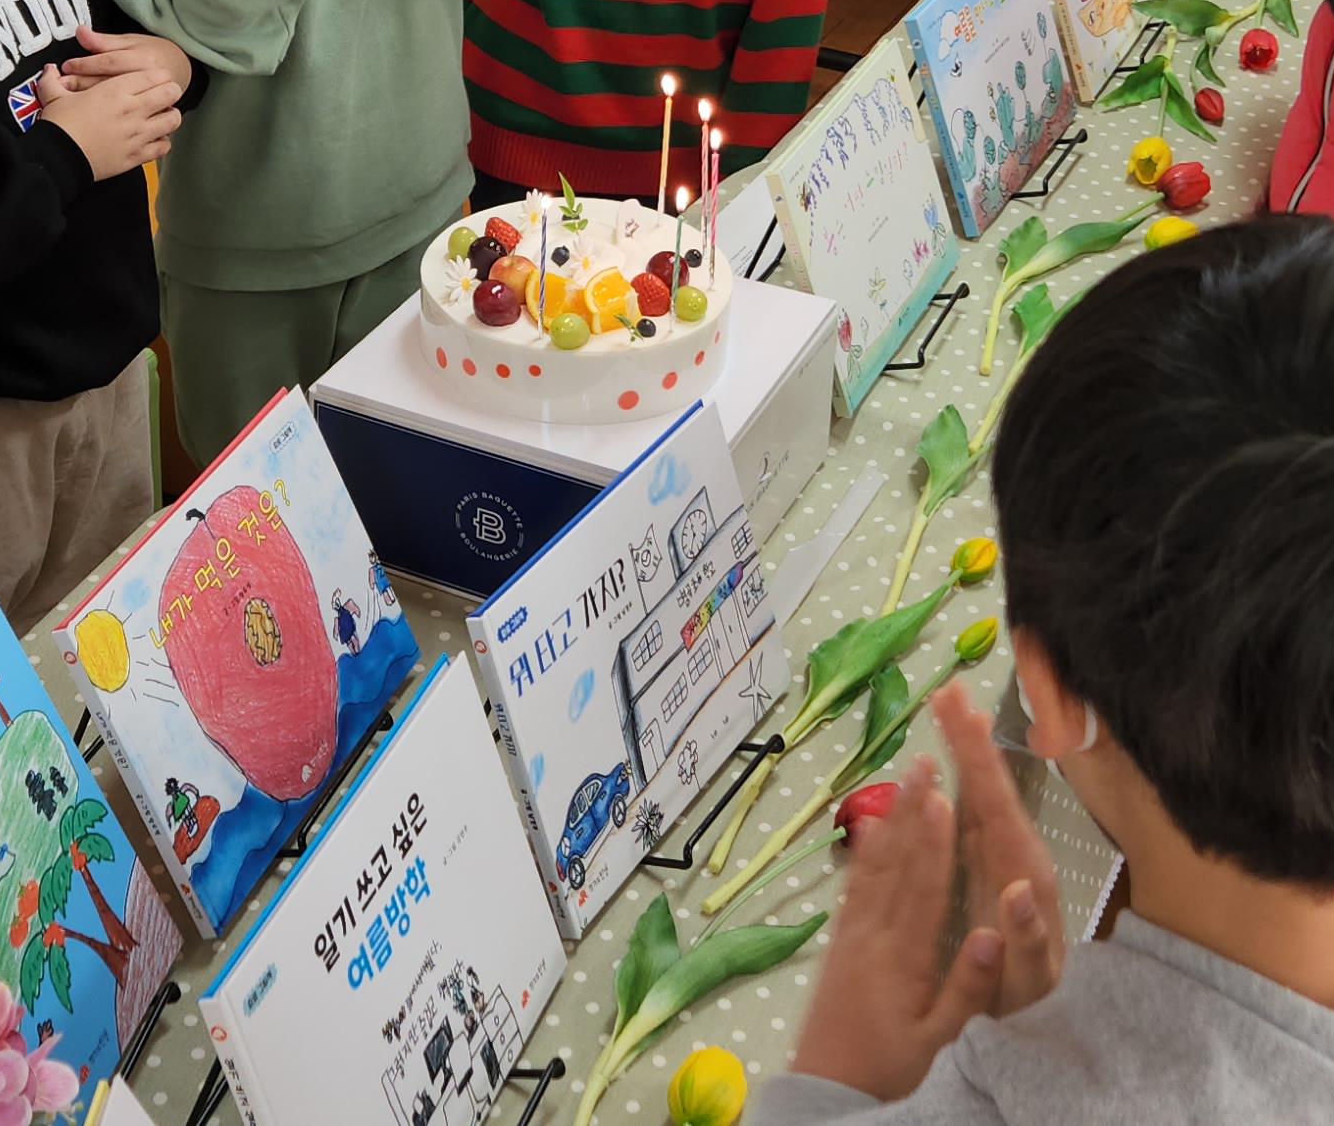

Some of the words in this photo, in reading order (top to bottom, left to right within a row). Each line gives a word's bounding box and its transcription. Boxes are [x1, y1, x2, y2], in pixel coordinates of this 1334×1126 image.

[149, 593, 193, 650] 내가
[193, 537, 241, 593] 먹은
[237, 479, 291, 547] 것은?
[456, 492, 478, 511] PARIS
[481, 492, 523, 529] BAGUETTE
[460, 532, 518, 561] BOULANGERIE
[473, 507, 506, 544] B
[509, 651, 535, 698] 뭐
[533, 608, 578, 676] 타고
[575, 558, 625, 629] 가지?
[314, 895, 357, 974] 일기
[356, 844, 393, 915] 쓰고
[392, 792, 428, 860] 싶은
[347, 855, 431, 991] 여름방학
